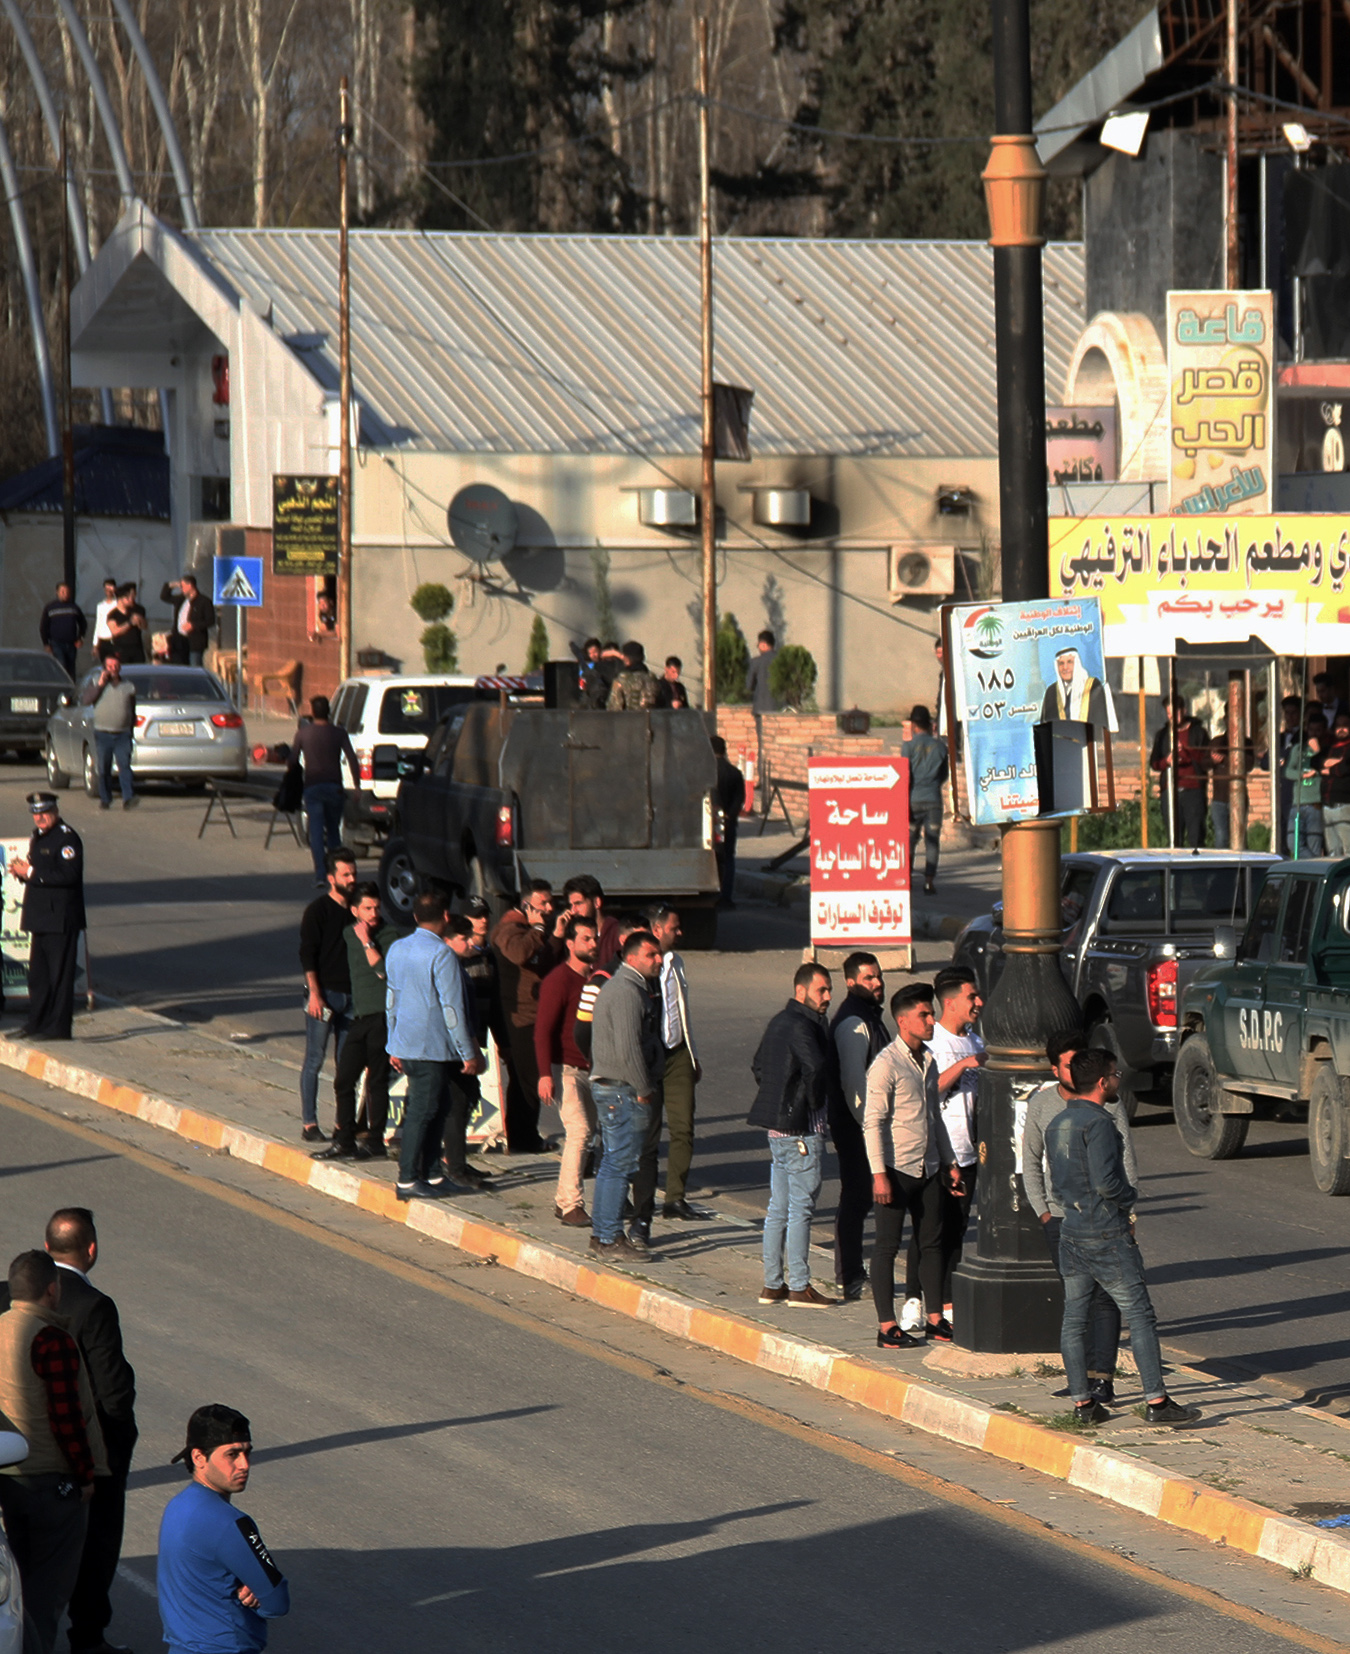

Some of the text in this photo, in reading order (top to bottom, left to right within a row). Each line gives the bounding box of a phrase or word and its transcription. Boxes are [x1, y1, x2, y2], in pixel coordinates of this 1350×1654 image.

[1178, 303, 1264, 346] قاعة
[1177, 361, 1262, 405] قصر
[1172, 413, 1266, 458] الحب
[1059, 521, 1151, 597] الترفيهي
[1158, 521, 1240, 589] الحدباء
[1246, 521, 1323, 589] ومطعم
[1020, 608, 1052, 622] الوطنية
[1157, 594, 1285, 619] يرحب بكم
[1013, 623, 1093, 640] الوطنية لكل العراقيين
[977, 668, 1015, 692] ١٨٥
[983, 701, 1038, 719] تسلسل ٥٣
[980, 763, 1037, 792] الد العاني
[825, 800, 889, 826] ساحة
[1001, 794, 1039, 813] ضيتنا
[814, 838, 906, 880] القرية السياحية
[817, 899, 903, 931] لوقوف السيارات
[1239, 1007, 1283, 1054] S.D.P.C
[248, 1533, 267, 1560] AIR
